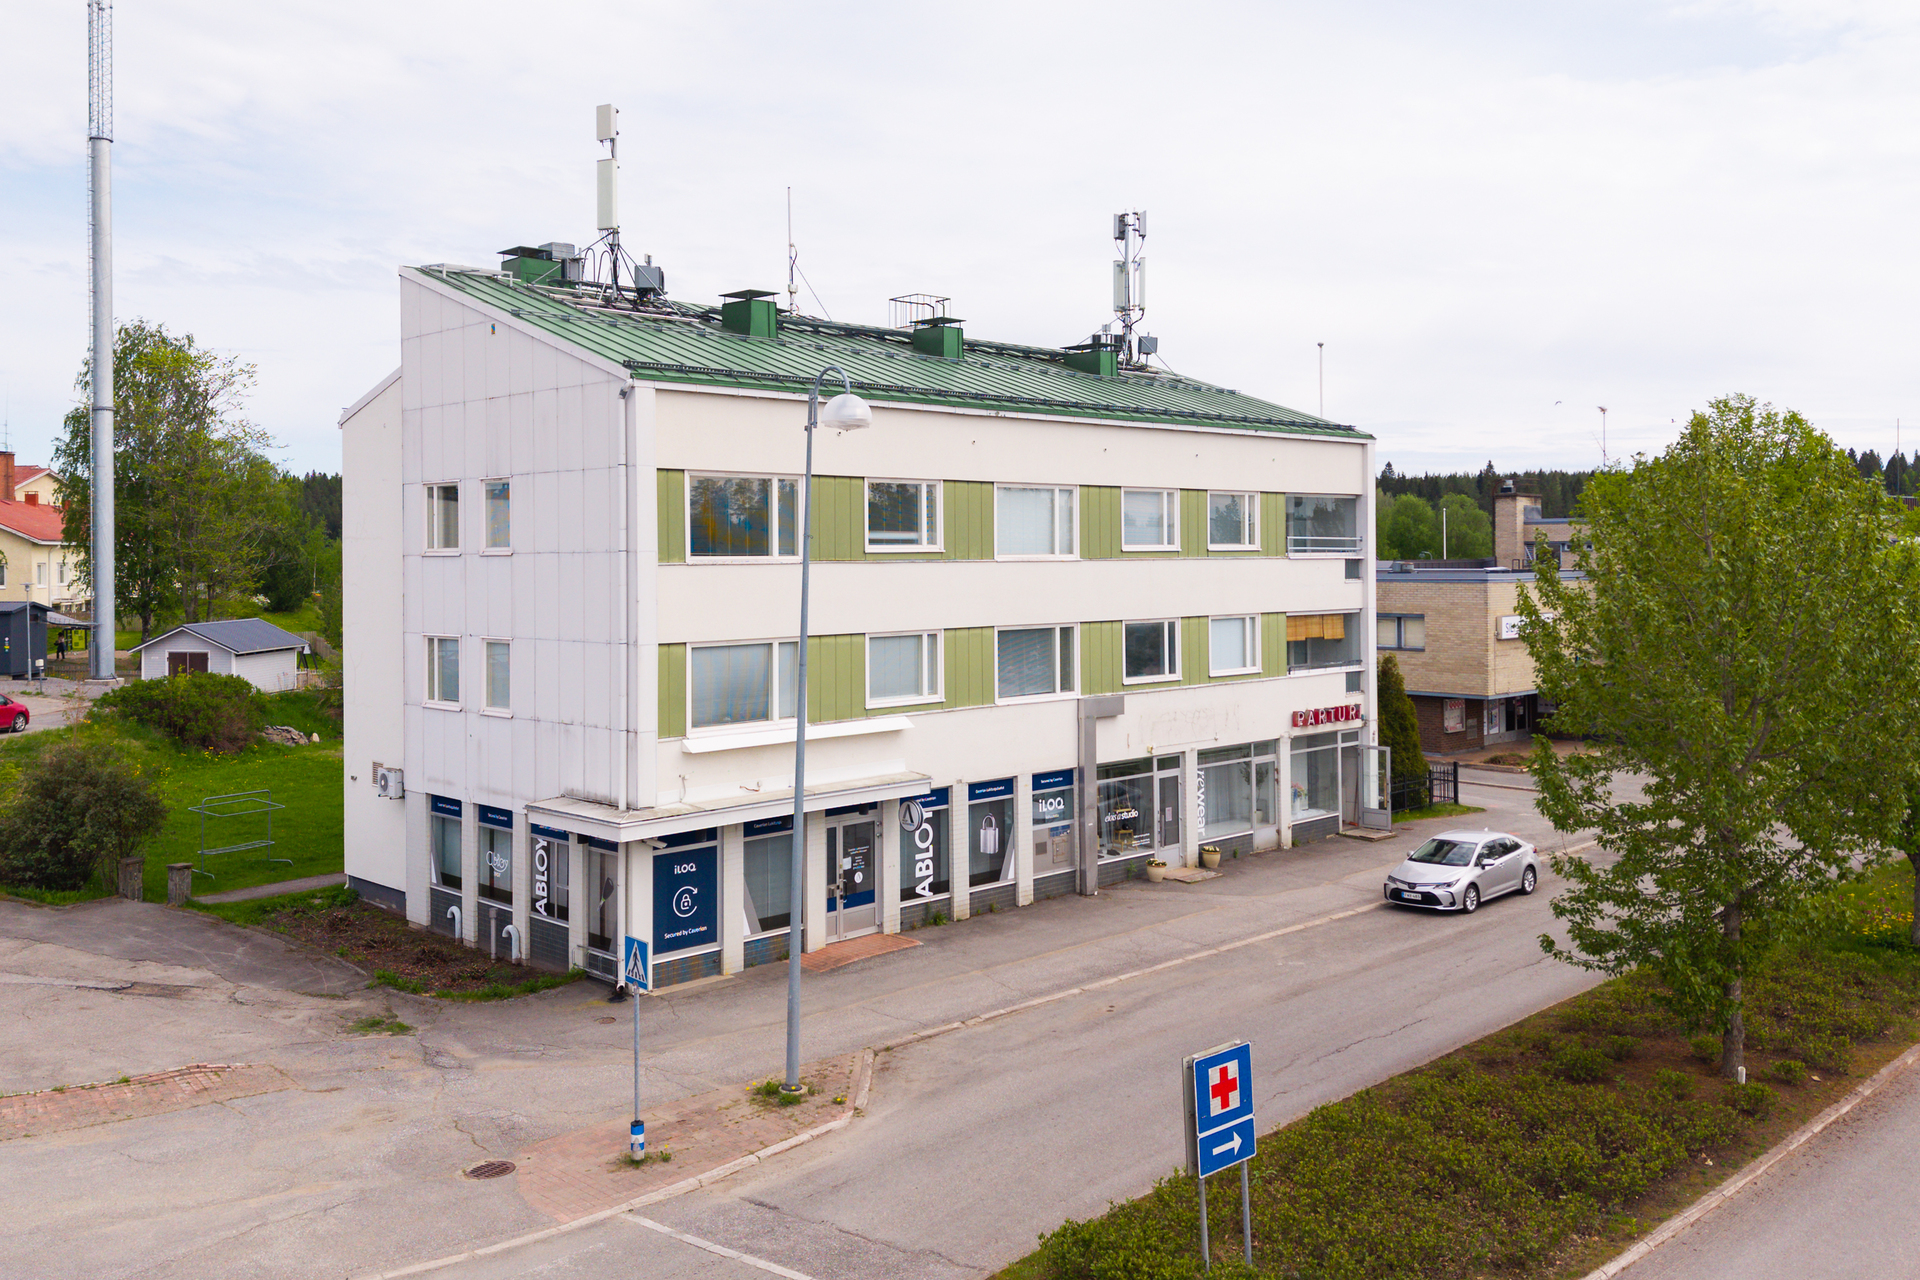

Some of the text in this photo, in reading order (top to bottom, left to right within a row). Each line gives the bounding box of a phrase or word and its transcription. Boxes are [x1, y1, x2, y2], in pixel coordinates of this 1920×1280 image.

[1292, 703, 1362, 728] PARTURI
[1039, 797, 1064, 812] iLOQ
[1196, 769, 1206, 836] rewear
[1121, 808, 1139, 820] studio
[674, 862, 697, 875] iLOQ
[535, 838, 548, 916] ABLOY
[664, 930, 682, 940] Secured
[688, 925, 708, 935] Caverion
